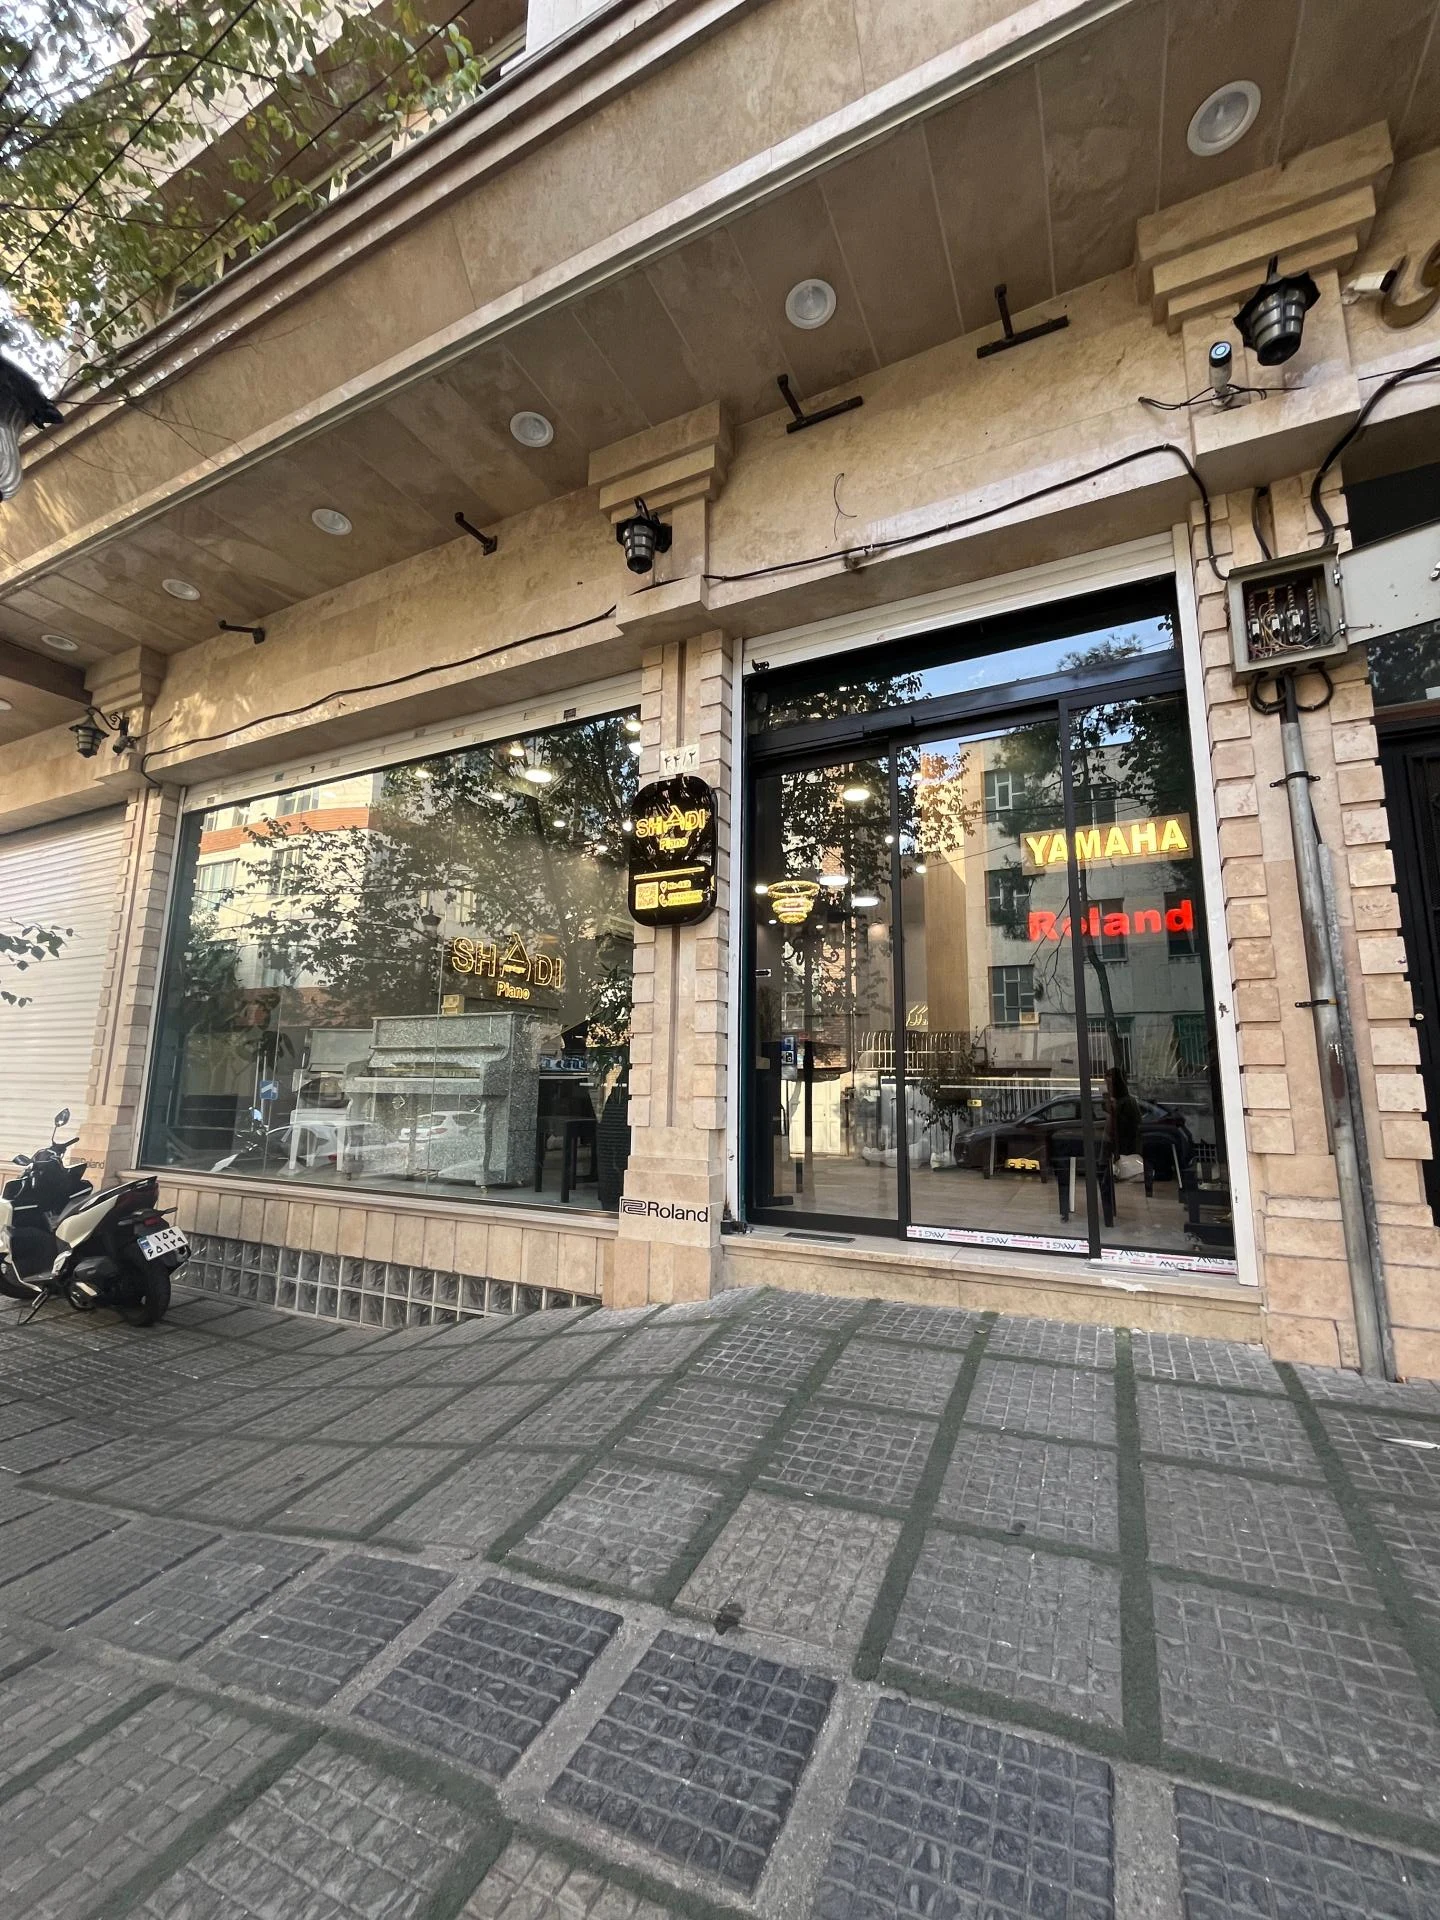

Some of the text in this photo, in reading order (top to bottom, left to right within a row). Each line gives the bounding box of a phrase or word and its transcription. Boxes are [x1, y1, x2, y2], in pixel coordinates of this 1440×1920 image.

[636, 805, 705, 838] SHADI
[659, 837, 688, 850] Piano
[1025, 819, 1188, 867] YAMAHA
[1028, 899, 1194, 942] Roland
[452, 932, 562, 988] SHADI
[497, 981, 530, 1000] Piano
[647, 1201, 709, 1223] Roland
[155, 1229, 176, 1242] ۱۵۹
[147, 1236, 185, 1257] ۶۵۱۲۹
[1159, 1260, 1185, 1271] MAG
